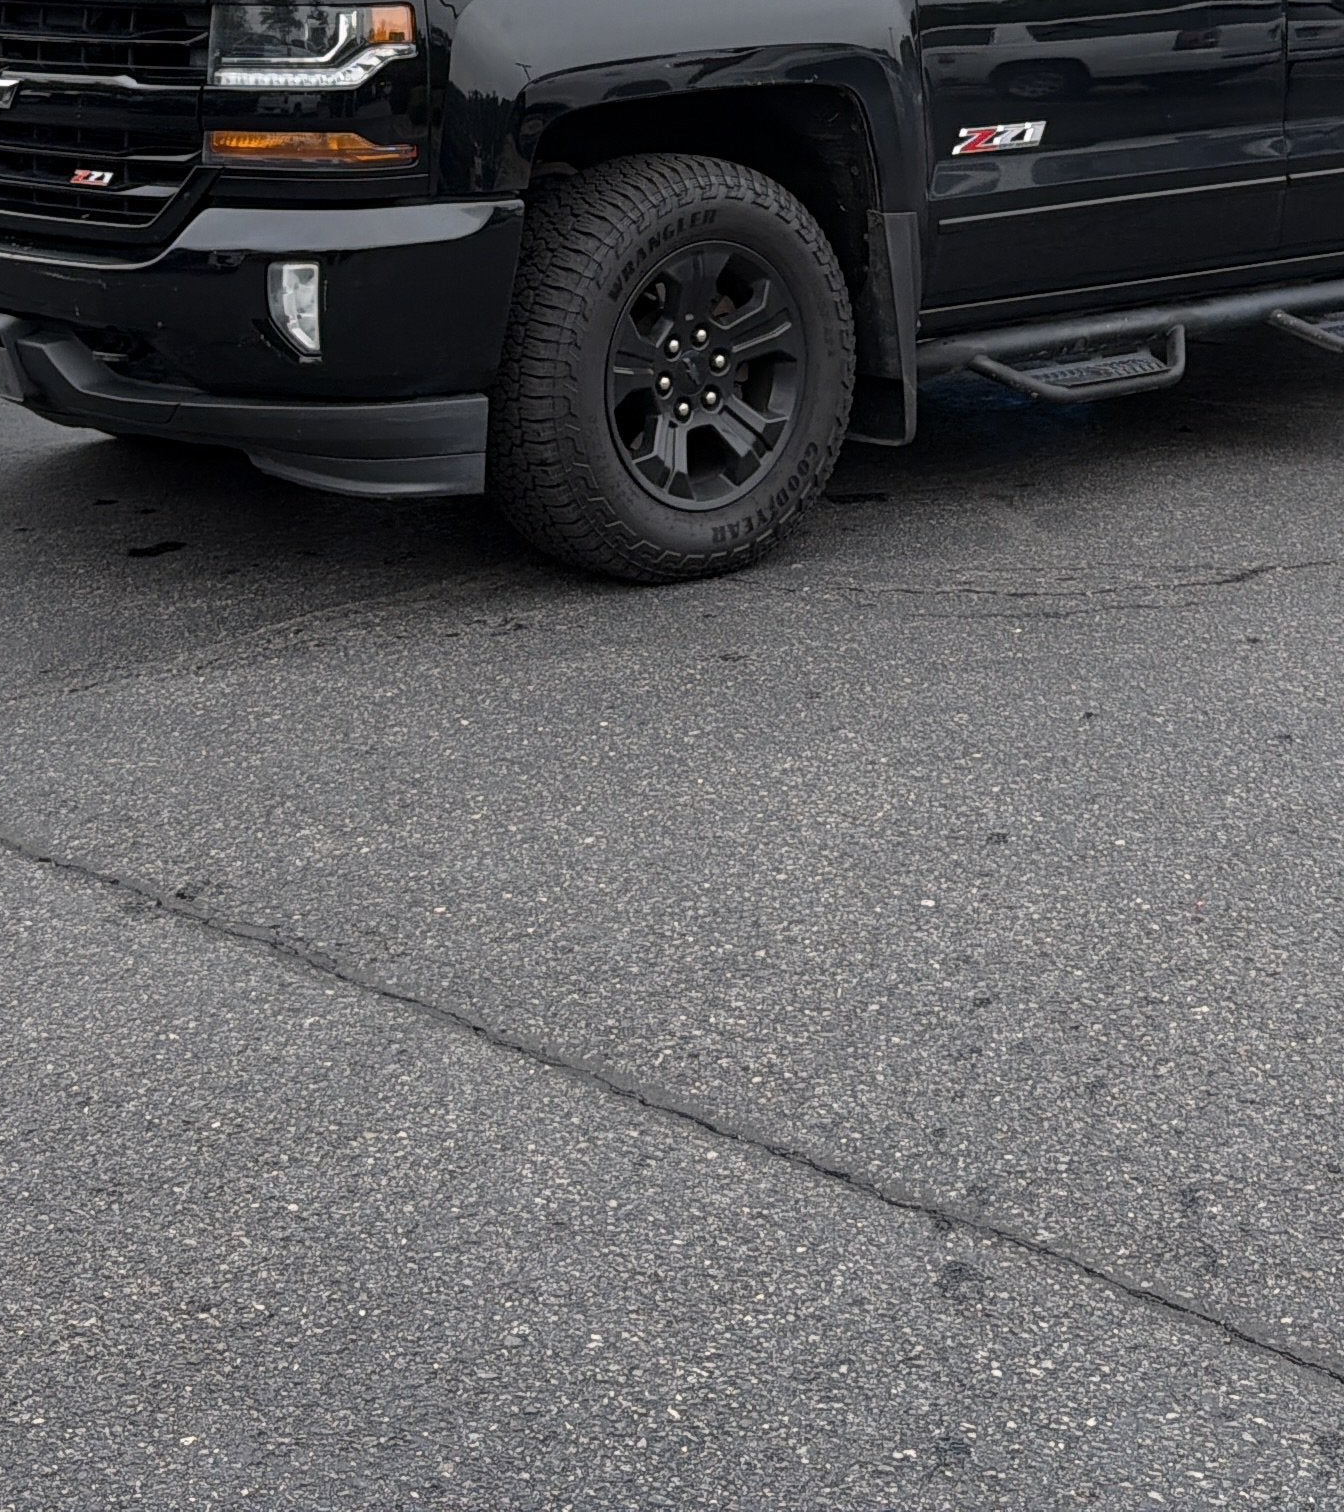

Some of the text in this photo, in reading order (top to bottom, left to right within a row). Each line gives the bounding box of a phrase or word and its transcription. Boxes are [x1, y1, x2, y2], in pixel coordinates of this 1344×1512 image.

[952, 120, 1047, 155] Z71
[70, 169, 114, 186] Z71
[608, 209, 716, 302] WRANGLER
[712, 441, 818, 544] GOODYEAR
